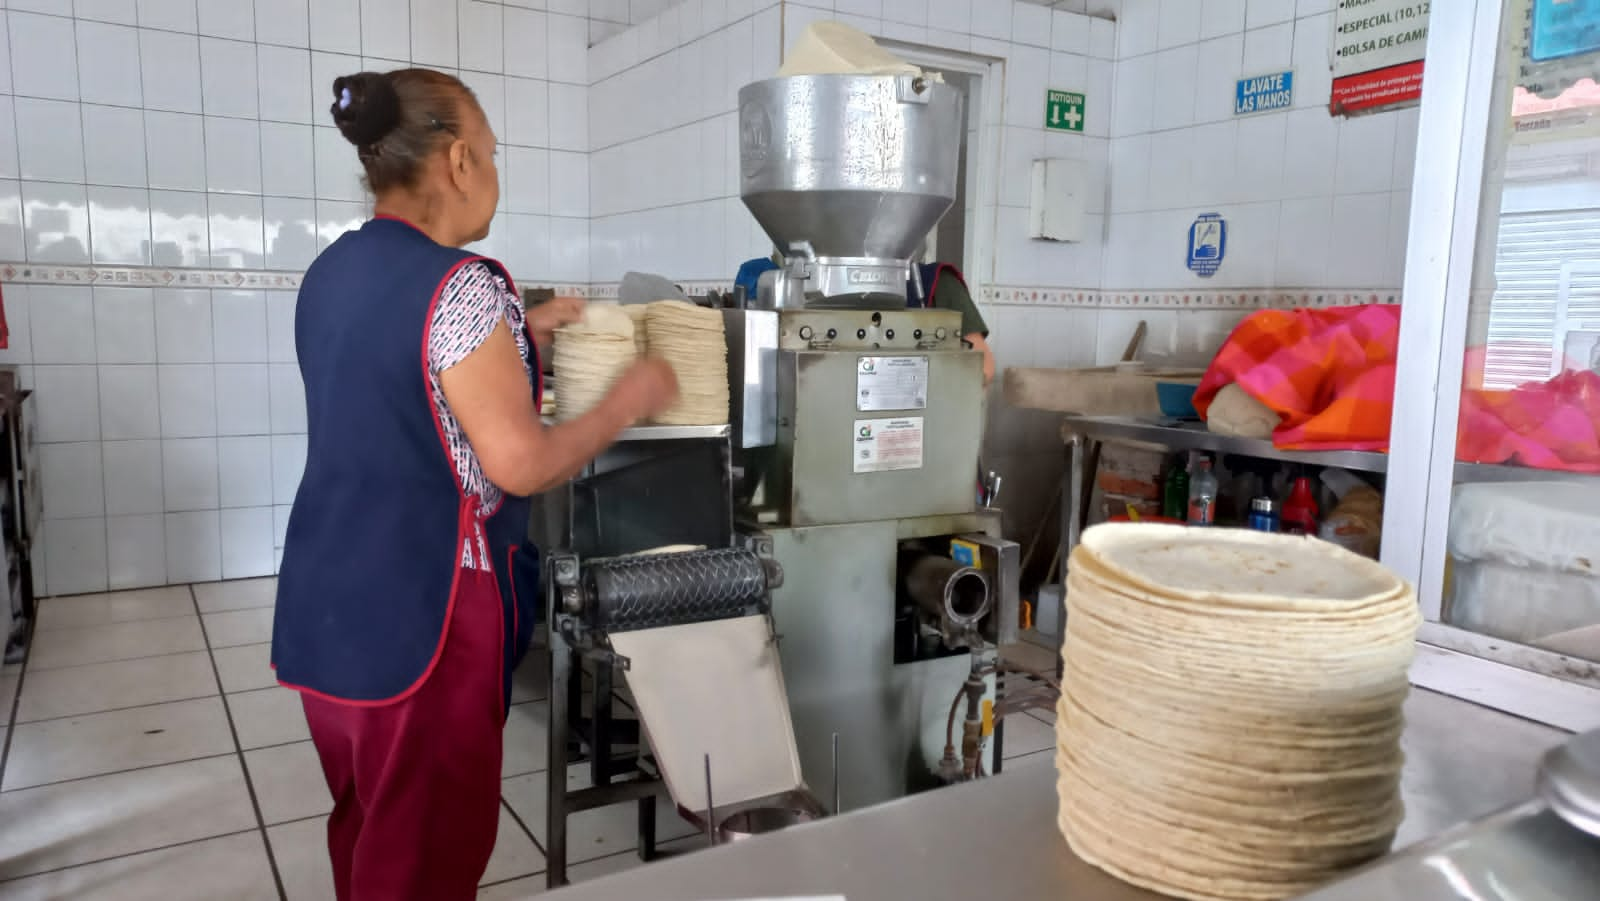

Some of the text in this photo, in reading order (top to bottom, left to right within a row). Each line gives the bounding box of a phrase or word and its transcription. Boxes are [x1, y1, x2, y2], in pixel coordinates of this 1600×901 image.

[1345, 0, 1373, 9] MAS
[1343, 14, 1392, 34] ESPECIAL
[1342, 40, 1376, 57] BOLSA
[1379, 35, 1394, 49] DE
[1244, 74, 1283, 95] LAVATE
[1050, 91, 1083, 105] BOTIQUIN
[1237, 90, 1290, 113] LAS MANOS
